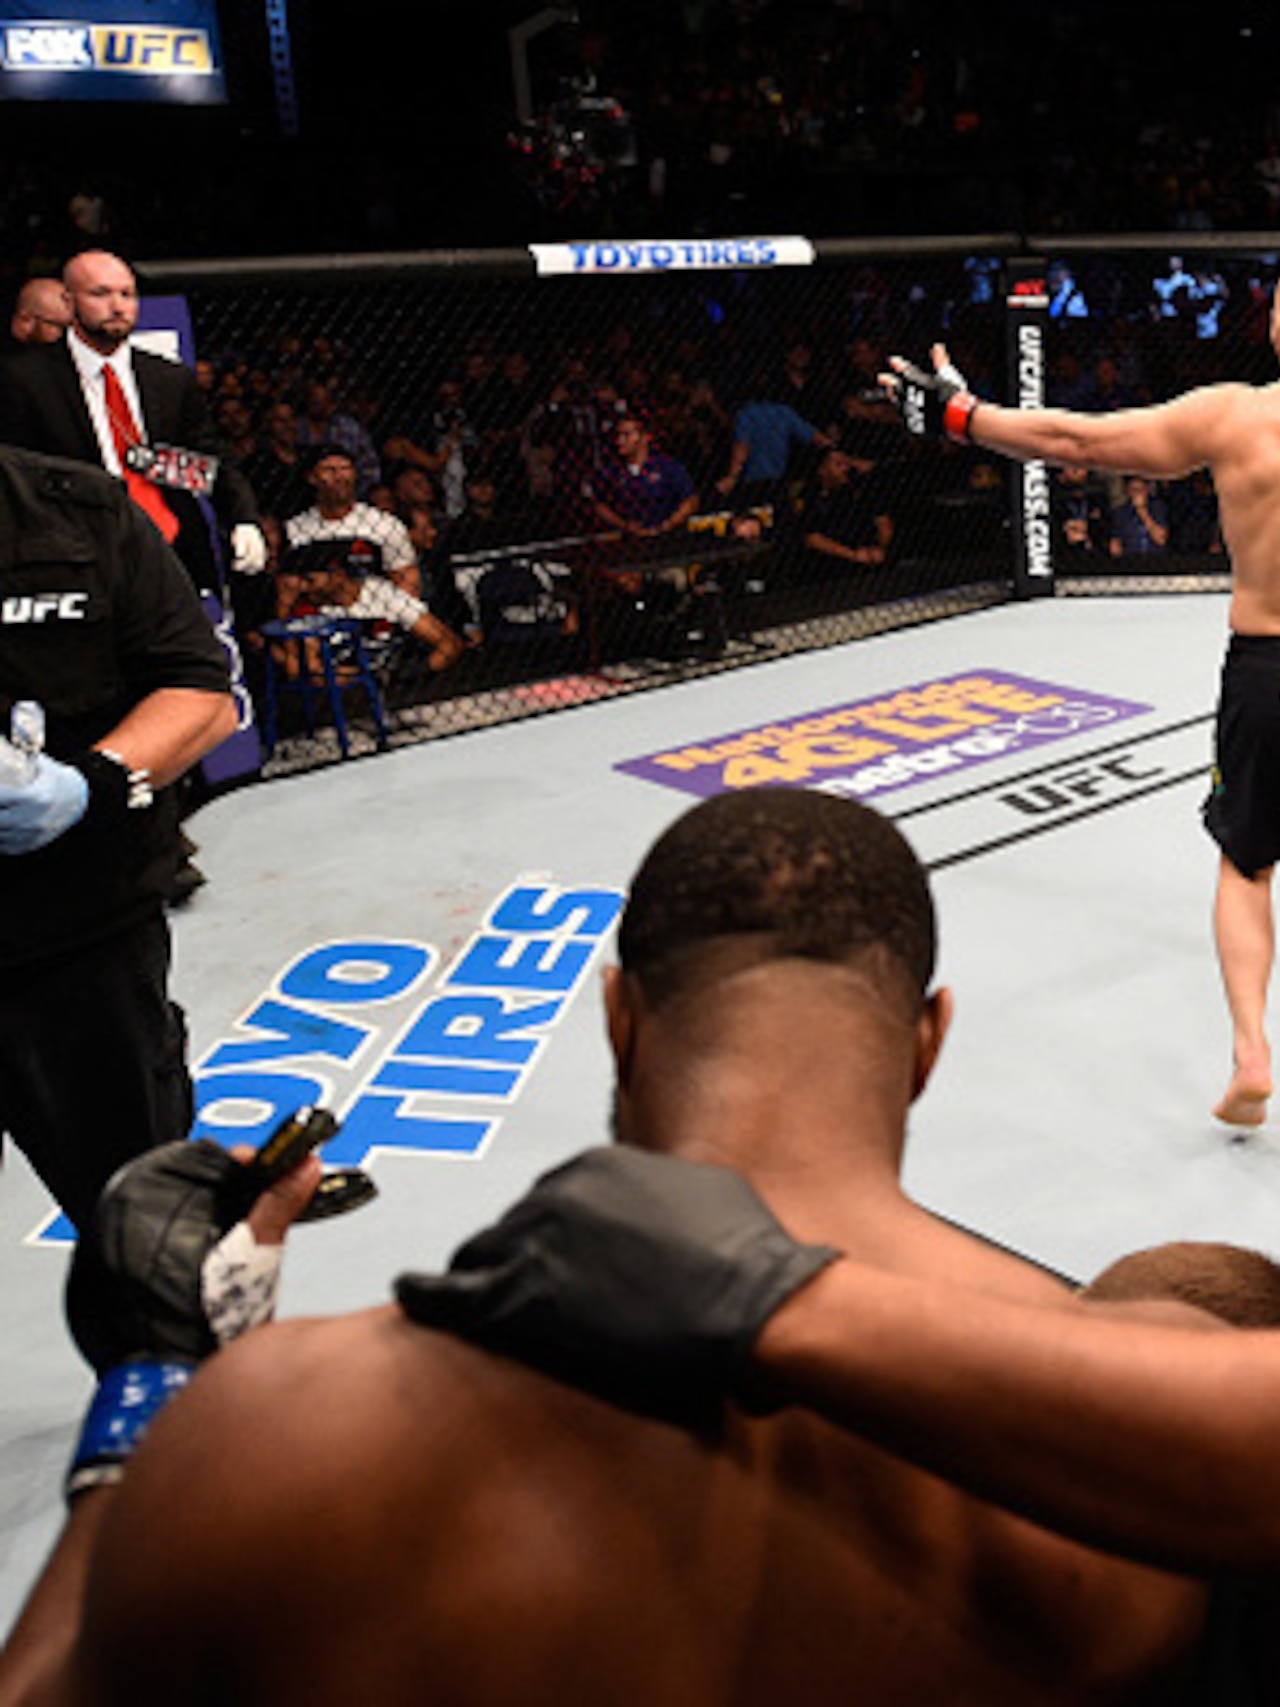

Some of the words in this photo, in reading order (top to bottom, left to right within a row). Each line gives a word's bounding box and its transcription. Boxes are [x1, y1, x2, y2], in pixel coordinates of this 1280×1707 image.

[104, 32, 199, 65] UFC
[569, 244, 674, 268] TOYO
[678, 240, 777, 264] TIRES
[3, 592, 89, 623] UFC
[723, 731, 898, 788] 4G
[862, 683, 1066, 741] LTE
[1000, 755, 1164, 814] UFC
[319, 885, 627, 1168] TIRES
